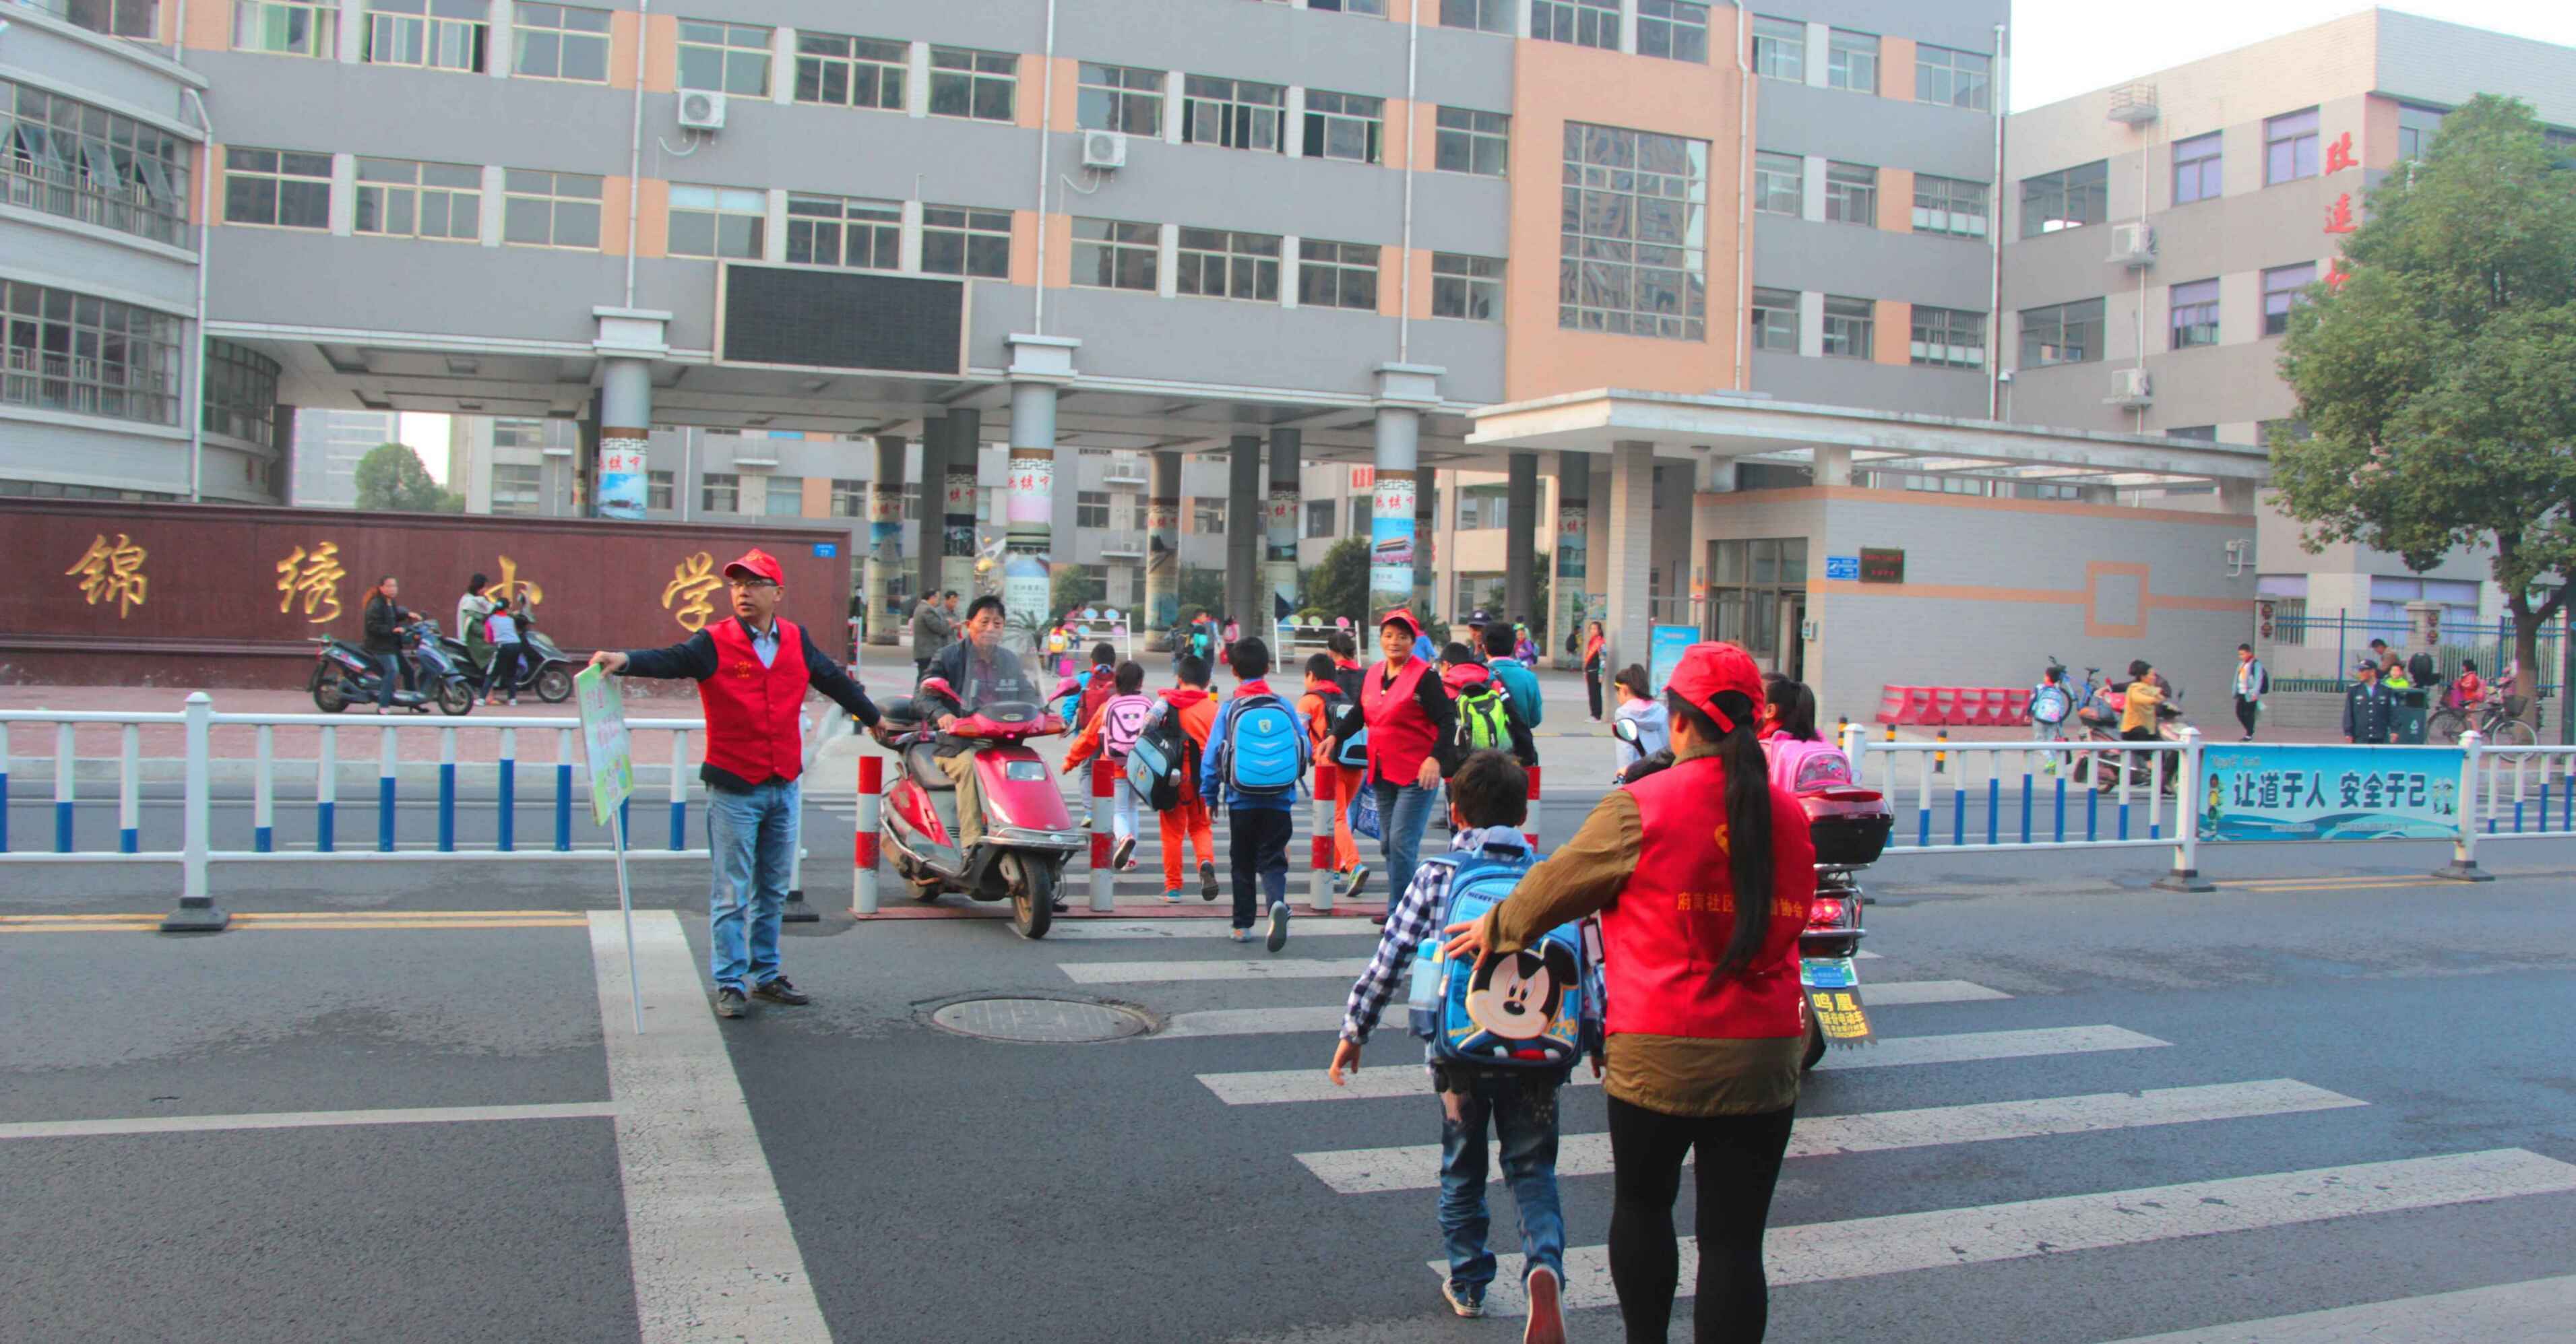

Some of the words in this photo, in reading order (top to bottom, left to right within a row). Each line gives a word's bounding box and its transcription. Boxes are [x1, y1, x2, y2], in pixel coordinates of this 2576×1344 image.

[65, 533, 723, 632] 锦绣小学
[2233, 771, 2327, 808] 让道于人
[2339, 770, 2426, 808] 安全于己
